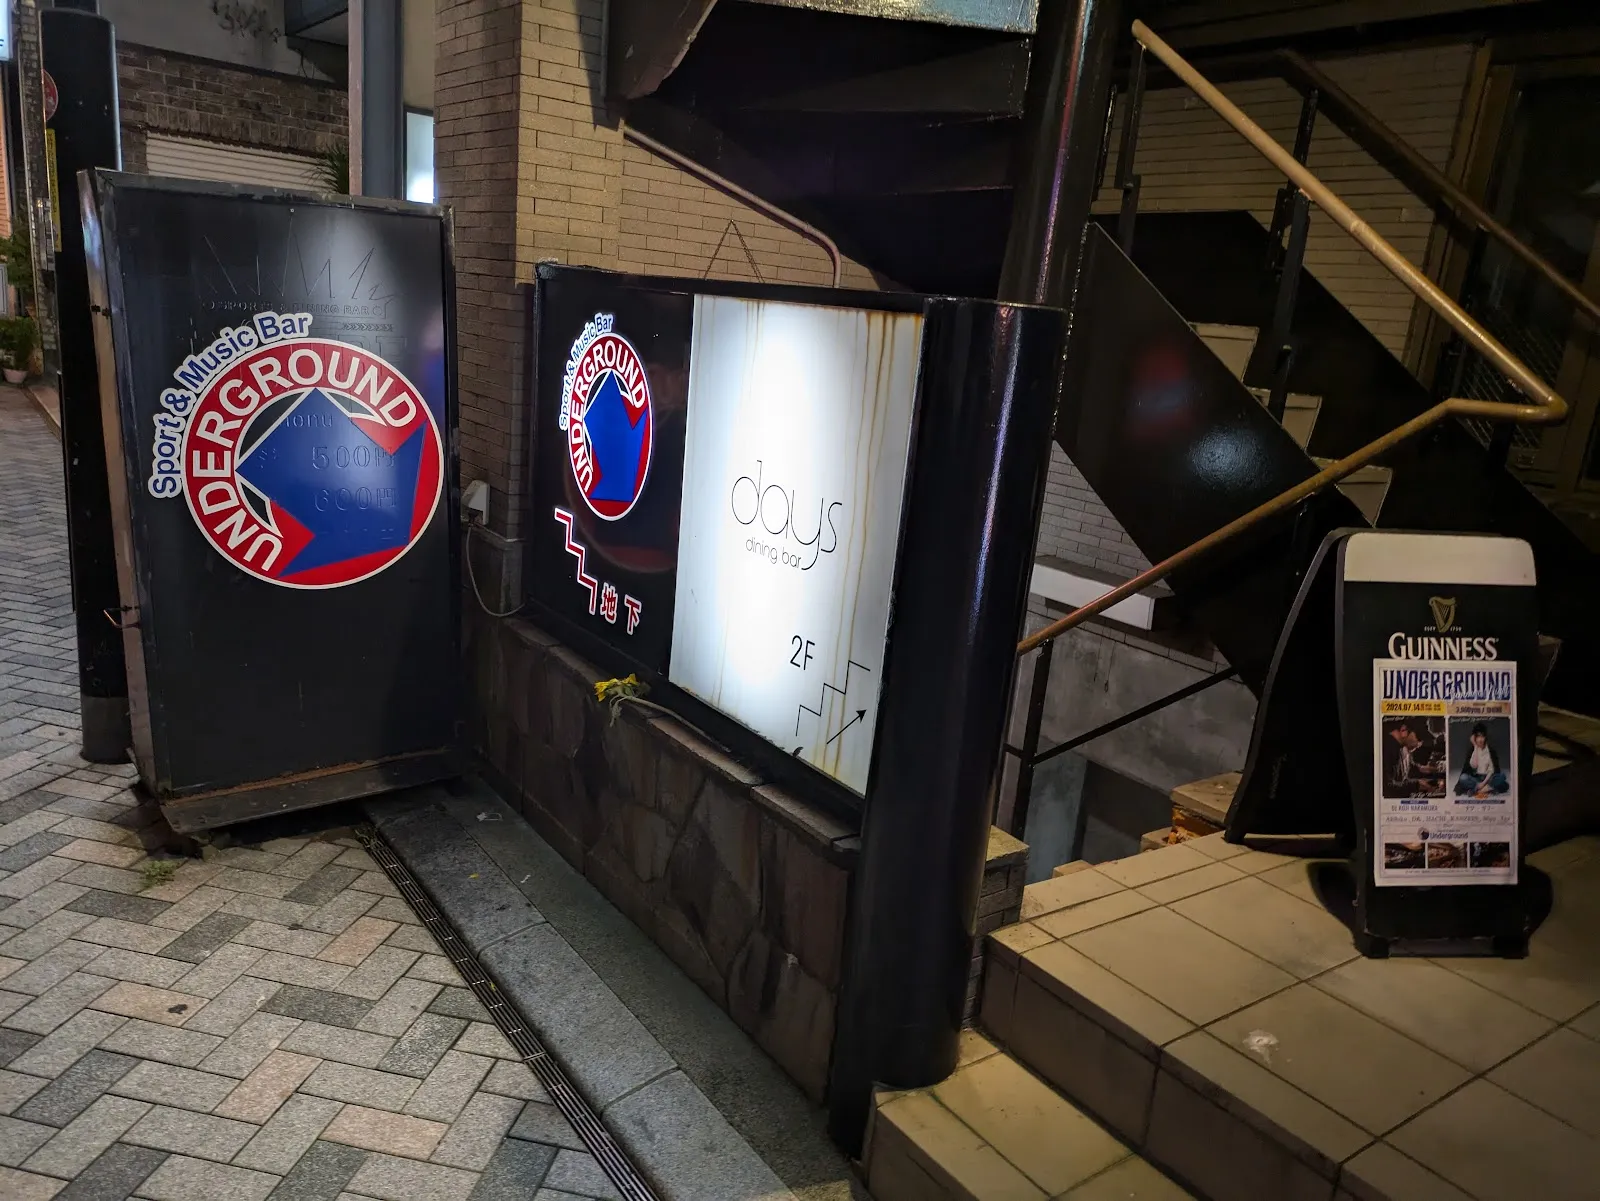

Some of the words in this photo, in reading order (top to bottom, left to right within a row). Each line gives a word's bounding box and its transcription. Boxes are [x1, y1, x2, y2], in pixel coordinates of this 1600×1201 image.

[257, 314, 309, 340] Bar
[343, 304, 370, 316] BAR
[595, 315, 612, 333] Bar
[178, 326, 255, 390] Music
[571, 324, 596, 359] Music
[566, 363, 576, 374] &
[164, 391, 192, 413] &
[560, 376, 573, 427] Sport
[571, 340, 646, 493] UNDERGROUND
[151, 416, 181, 496] Sport
[193, 349, 417, 572] UNDERGROUND
[731, 459, 843, 570] days
[745, 536, 778, 564] dining
[781, 546, 802, 569] bar
[600, 582, 642, 635] 地下
[789, 634, 816, 671] 2F
[1388, 632, 1499, 660] GUINNESS
[1383, 670, 1511, 700] UNDERGROUND
